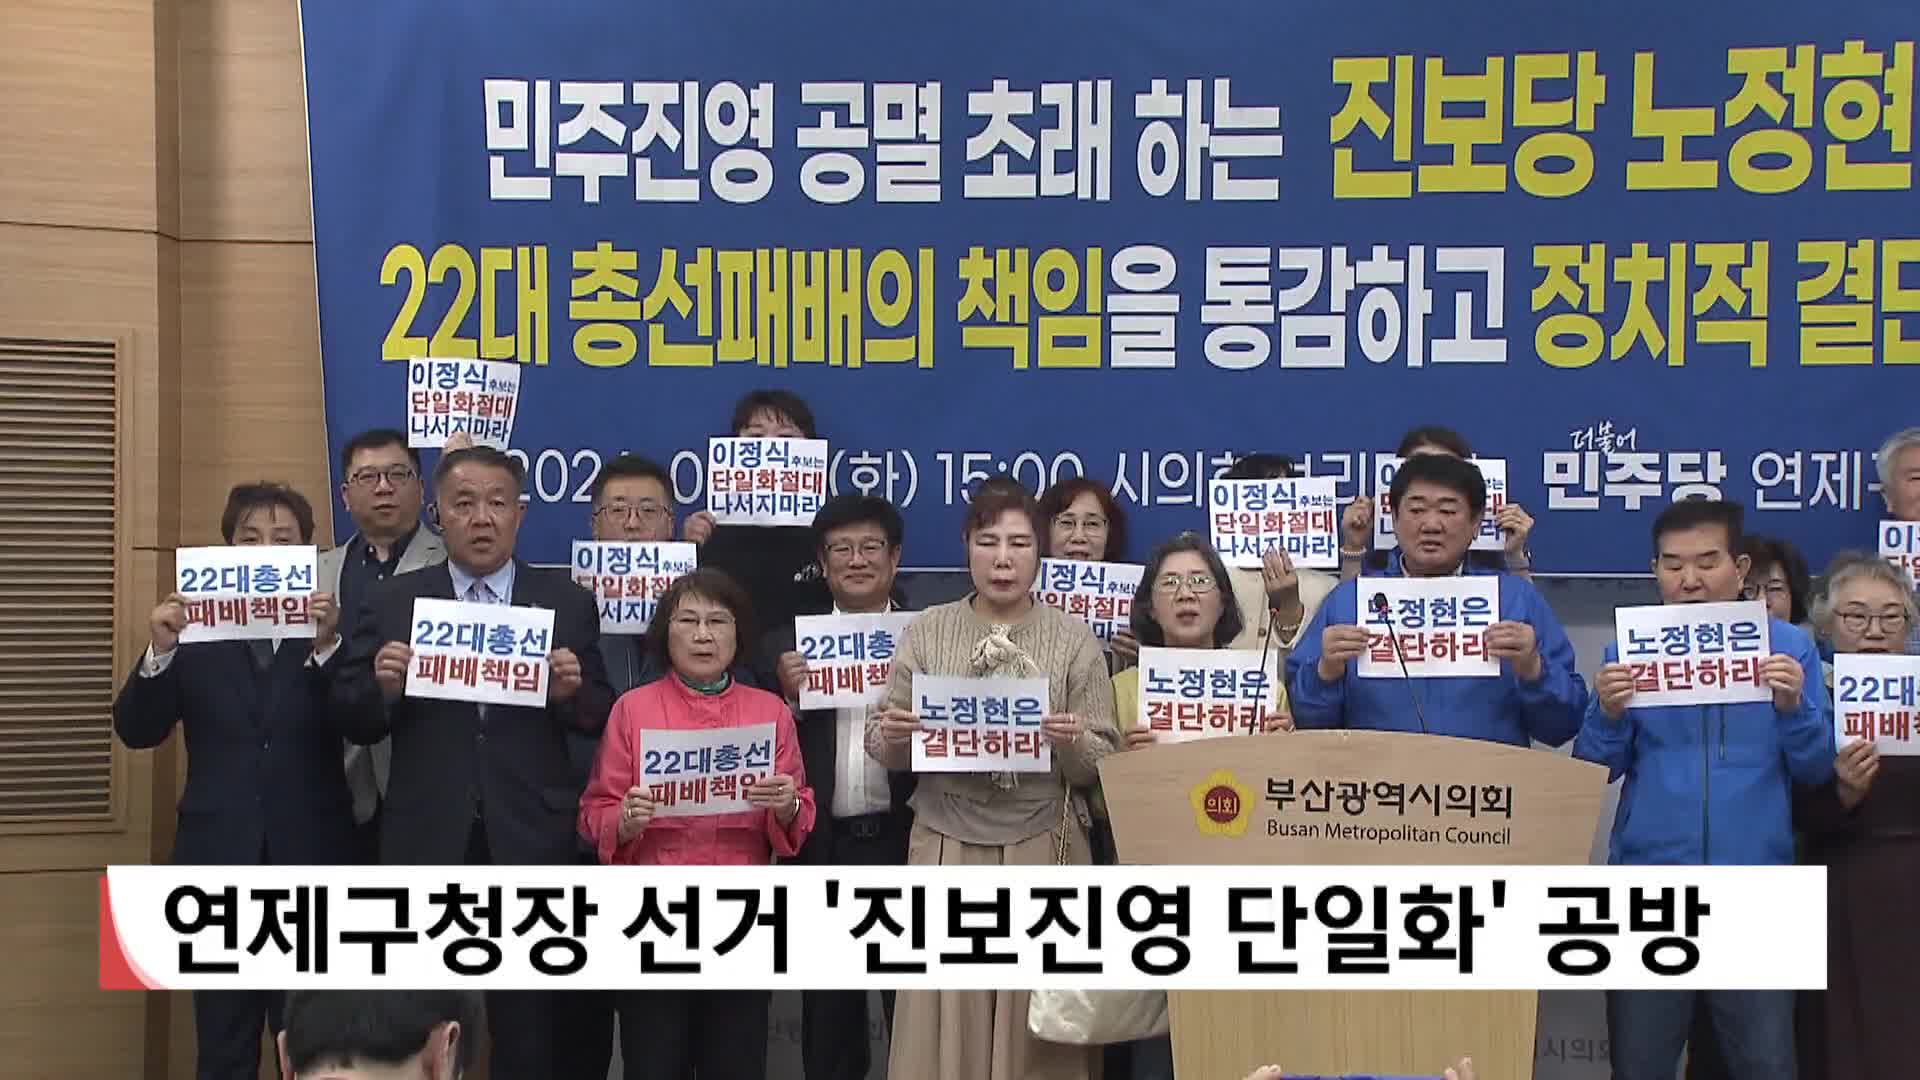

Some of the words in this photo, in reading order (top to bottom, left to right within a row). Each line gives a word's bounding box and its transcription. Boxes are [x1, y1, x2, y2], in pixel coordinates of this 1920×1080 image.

[484, 79, 775, 203] 민주진영
[796, 79, 942, 203] 공멸
[963, 78, 1112, 202] 초래
[1135, 78, 1284, 201] 하는
[1330, 50, 1606, 198] 진보당
[1625, 40, 1915, 194] 노정현
[379, 243, 549, 367] 22대
[567, 242, 934, 369] 총선패배의
[957, 244, 1181, 369] 책임을
[1201, 244, 1508, 370] 통감하고
[1531, 240, 1768, 368] 정치적
[412, 361, 488, 391] 이정식
[412, 390, 513, 420] 단일화절대
[411, 414, 509, 442] 나서지마라
[1570, 421, 1637, 454] 더불어
[714, 441, 788, 467] 이정식
[712, 469, 822, 495] 단일화절대
[1543, 451, 1727, 510] 민주당
[1752, 450, 1882, 510] 연제
[712, 493, 822, 516] 나서지마라
[1214, 482, 1297, 511] 이정식
[1215, 509, 1334, 535] 단일화절대
[577, 546, 660, 575] 이정식
[181, 564, 312, 593] 22대총선
[185, 596, 309, 627] 패배책임
[1366, 596, 1491, 629] 노정현은
[416, 619, 548, 658] 22대총선
[801, 630, 896, 660] 22대총
[1627, 621, 1761, 656] 노정현은
[416, 654, 541, 694] 패배책임
[807, 663, 890, 696] 패배책
[1146, 668, 1270, 699] 노정현은
[1840, 675, 1920, 706] 22대
[920, 694, 1042, 725] 노정현은
[1147, 702, 1269, 734] 결단하라
[1844, 711, 1920, 742] 패배
[645, 739, 771, 775] 22대총선
[921, 728, 1046, 759] 결단하라
[1206, 797, 1237, 814] 의회
[1265, 777, 1512, 819] 부산광역시의회
[1267, 819, 1319, 838] Busan
[1325, 822, 1440, 844] Metropolitan
[1446, 827, 1511, 845] Council
